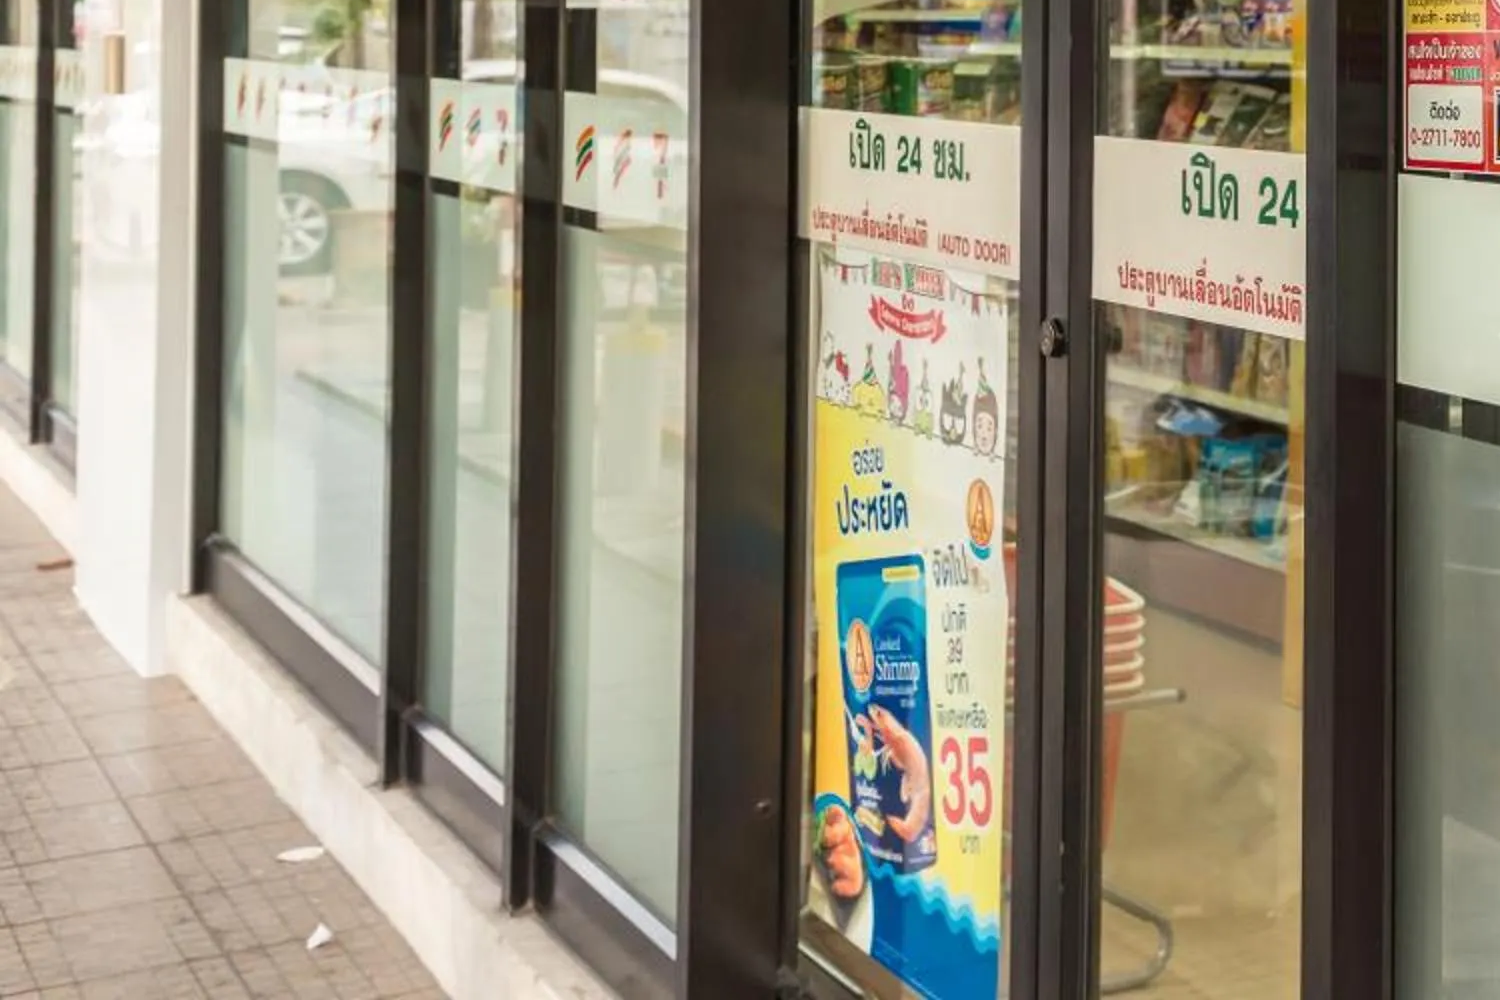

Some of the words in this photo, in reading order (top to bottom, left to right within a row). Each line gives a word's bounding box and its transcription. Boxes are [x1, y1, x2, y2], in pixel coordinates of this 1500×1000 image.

[848, 117, 886, 172] เปิด
[896, 135, 923, 175] 24
[933, 138, 971, 182] ชม.
[1181, 150, 1240, 222] เปิด
[1257, 178, 1300, 229] 24
[836, 479, 909, 536] ประหยัด
[940, 735, 993, 827] 35
